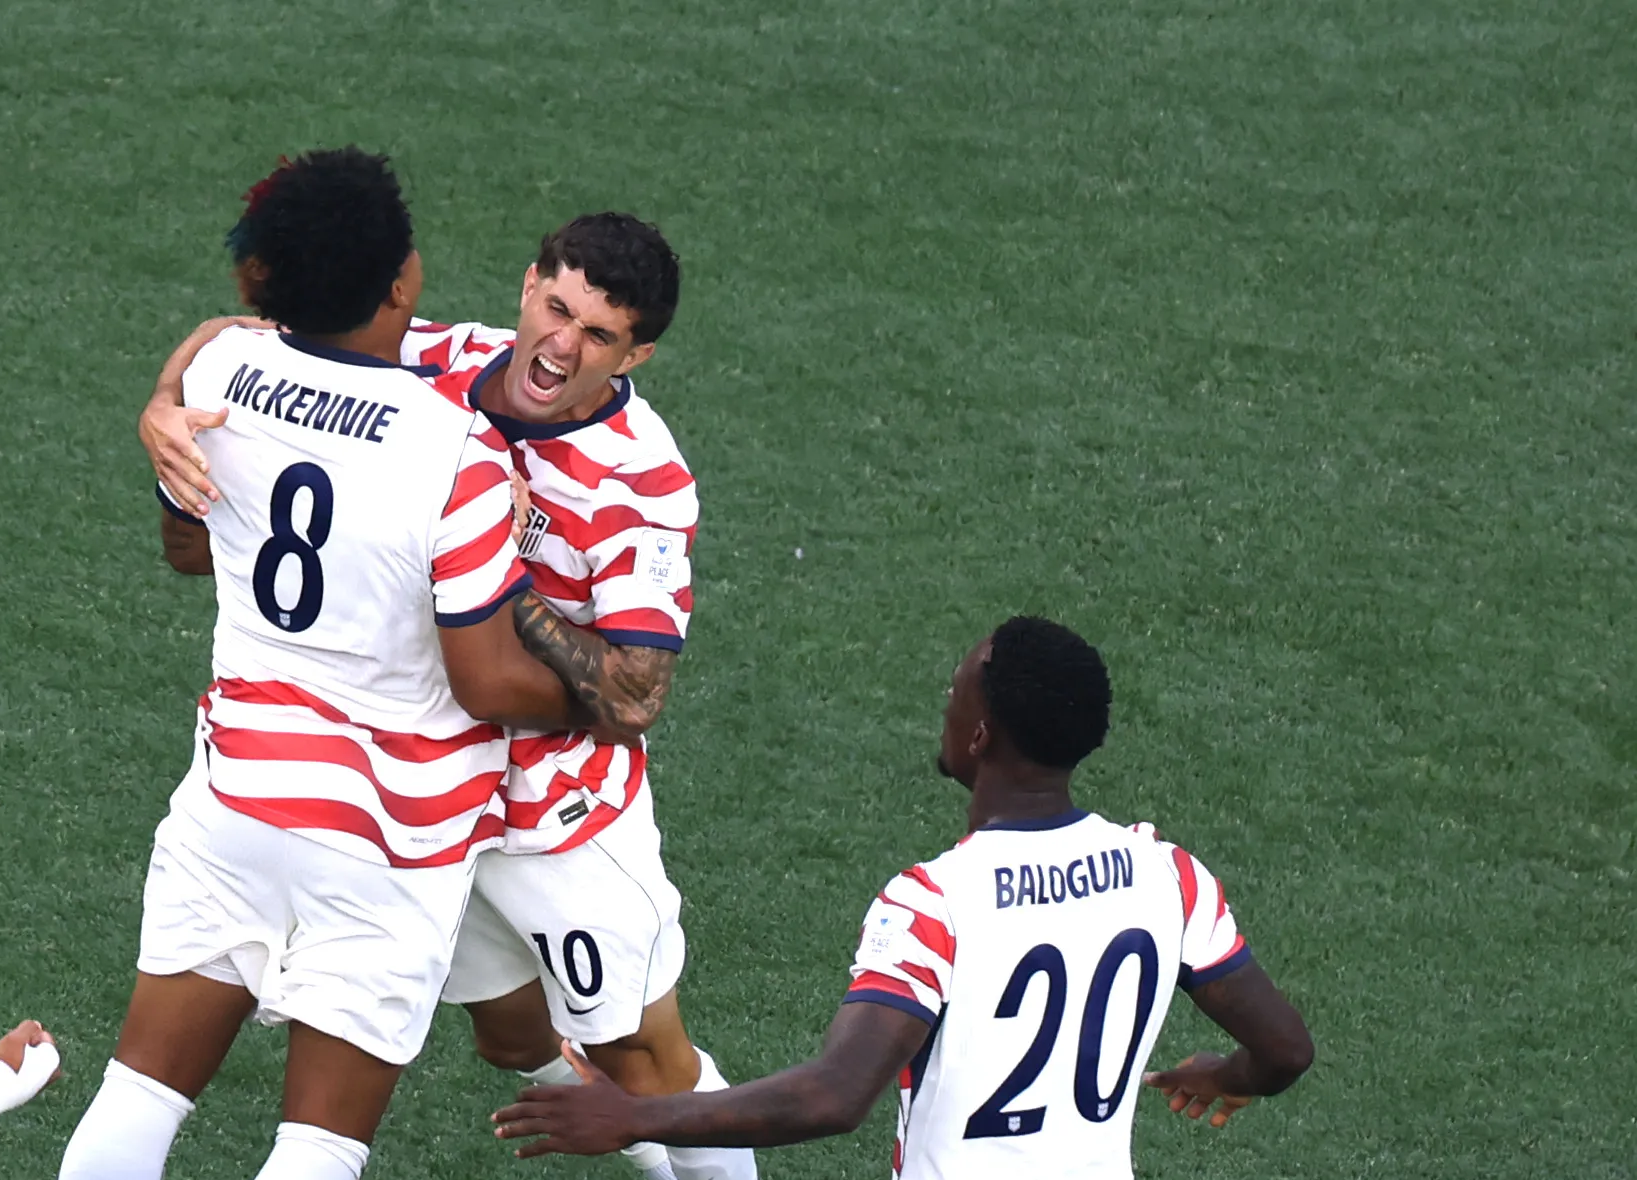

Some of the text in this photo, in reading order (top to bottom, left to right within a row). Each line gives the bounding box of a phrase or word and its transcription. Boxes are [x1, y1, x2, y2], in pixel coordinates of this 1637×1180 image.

[224, 363, 400, 443] McKENNIE
[252, 461, 334, 633] 8
[994, 847, 1133, 909] BALOGUN
[531, 929, 604, 998] 10
[963, 928, 1159, 1140] 20
